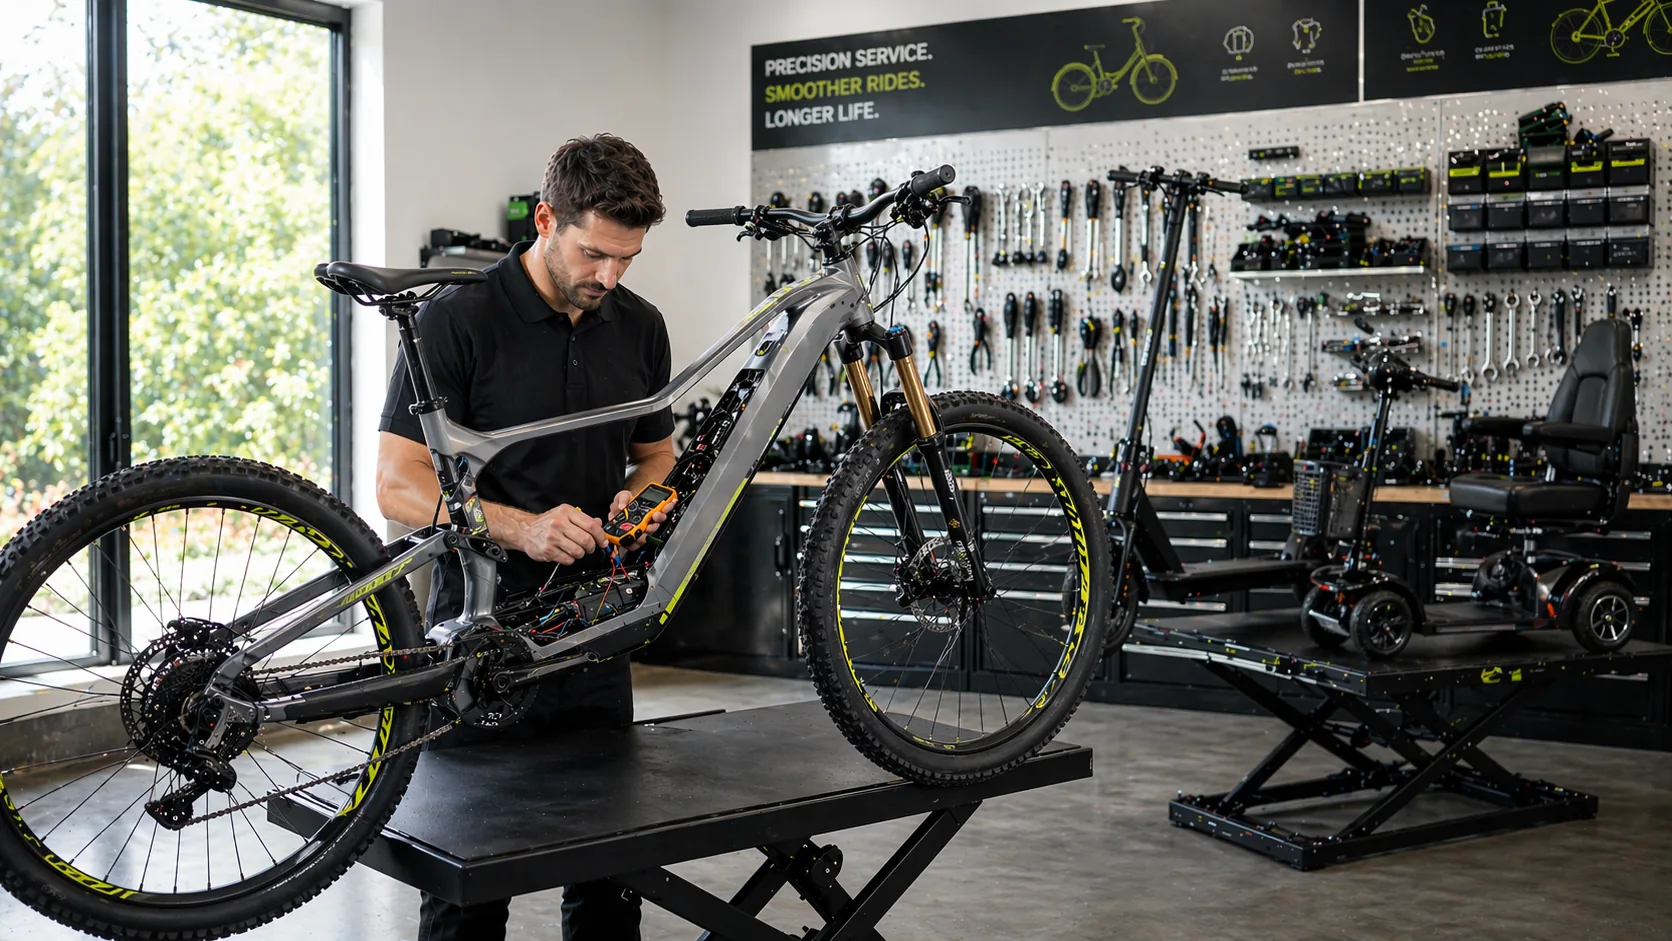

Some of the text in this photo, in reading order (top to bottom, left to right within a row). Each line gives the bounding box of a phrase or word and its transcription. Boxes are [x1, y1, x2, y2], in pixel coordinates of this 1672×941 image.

[765, 43, 933, 77] PRECISION SERVICE.
[765, 71, 926, 103] SMOOTHER RIDES.
[765, 101, 880, 129] LONGER LIFE.
